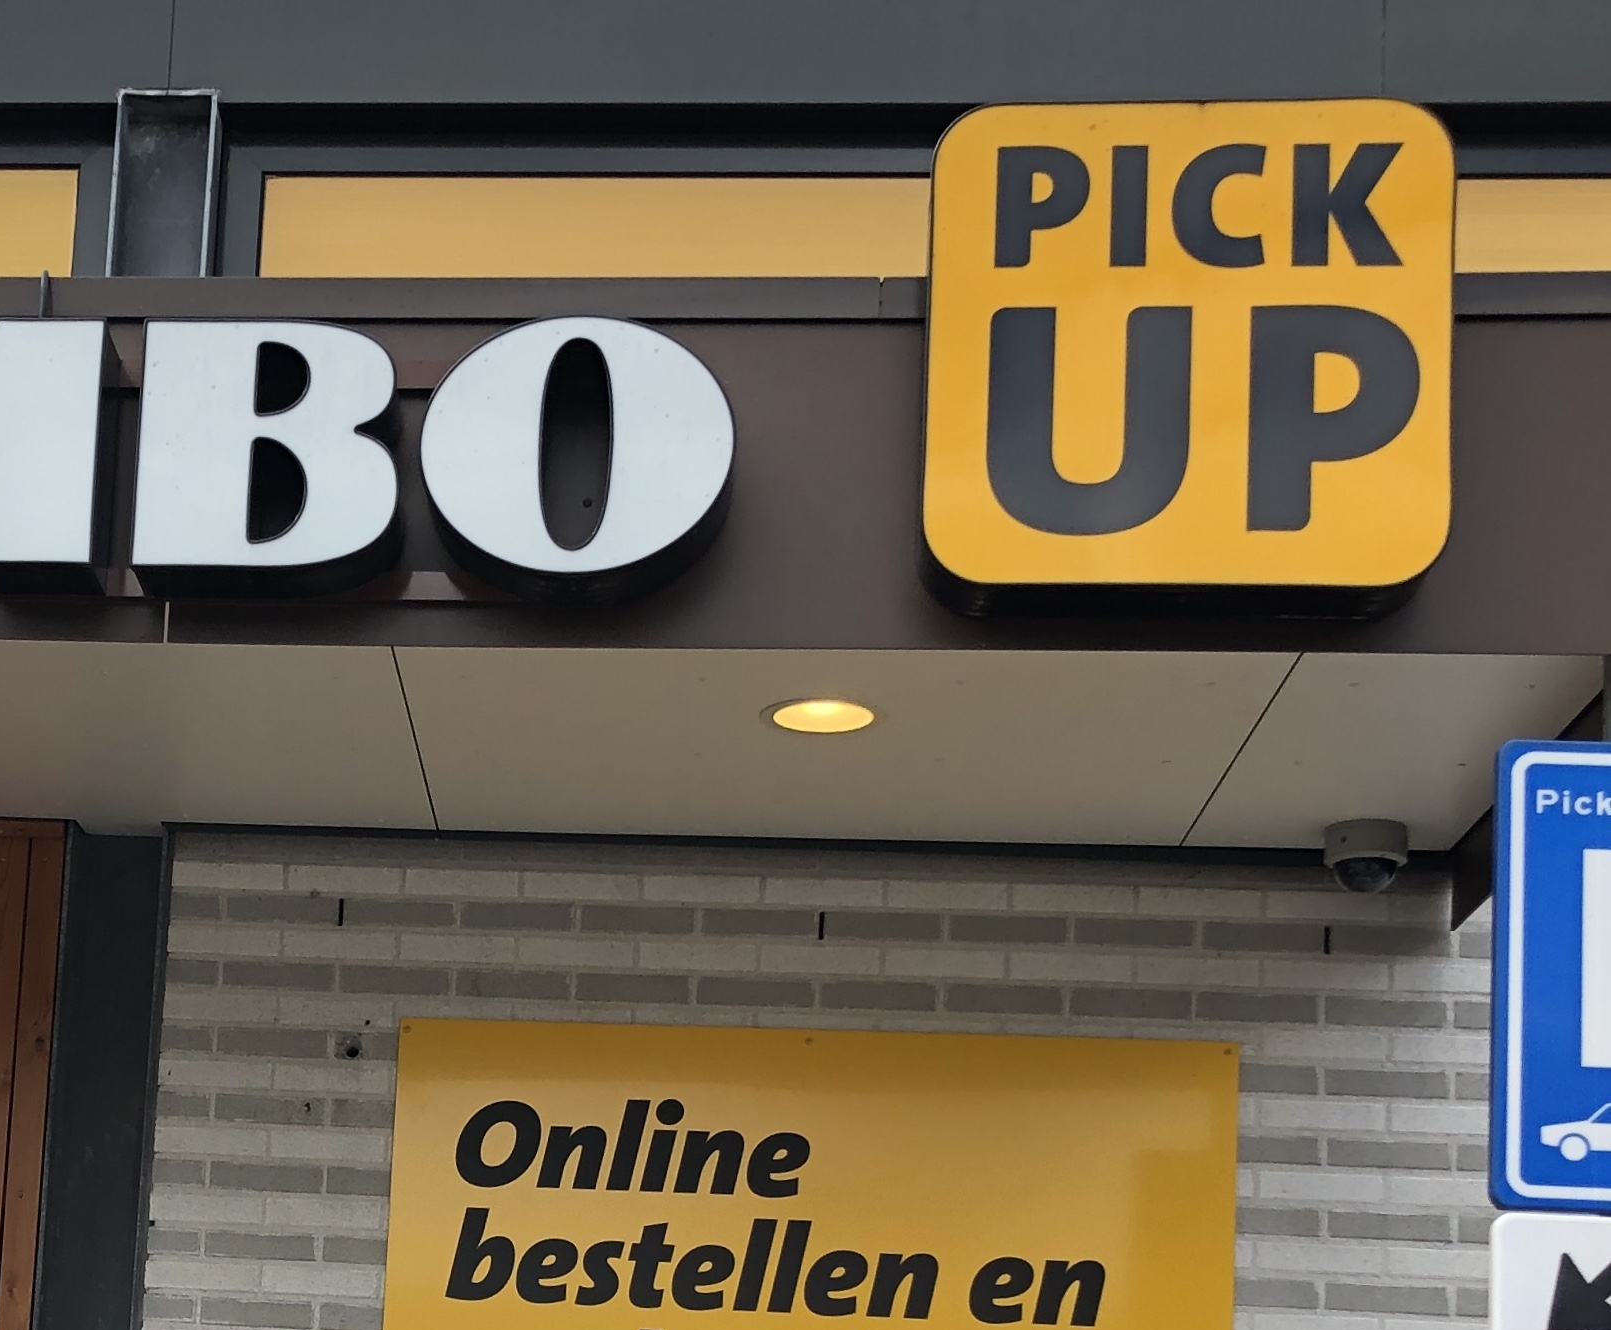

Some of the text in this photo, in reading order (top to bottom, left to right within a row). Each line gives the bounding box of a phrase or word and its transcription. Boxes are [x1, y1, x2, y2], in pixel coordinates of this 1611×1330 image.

[994, 142, 1405, 268] PICK
[986, 304, 1421, 536] UP
[1536, 789, 1611, 816] Pick
[454, 1098, 811, 1198] Online
[445, 1207, 1106, 1326] bestellen en
